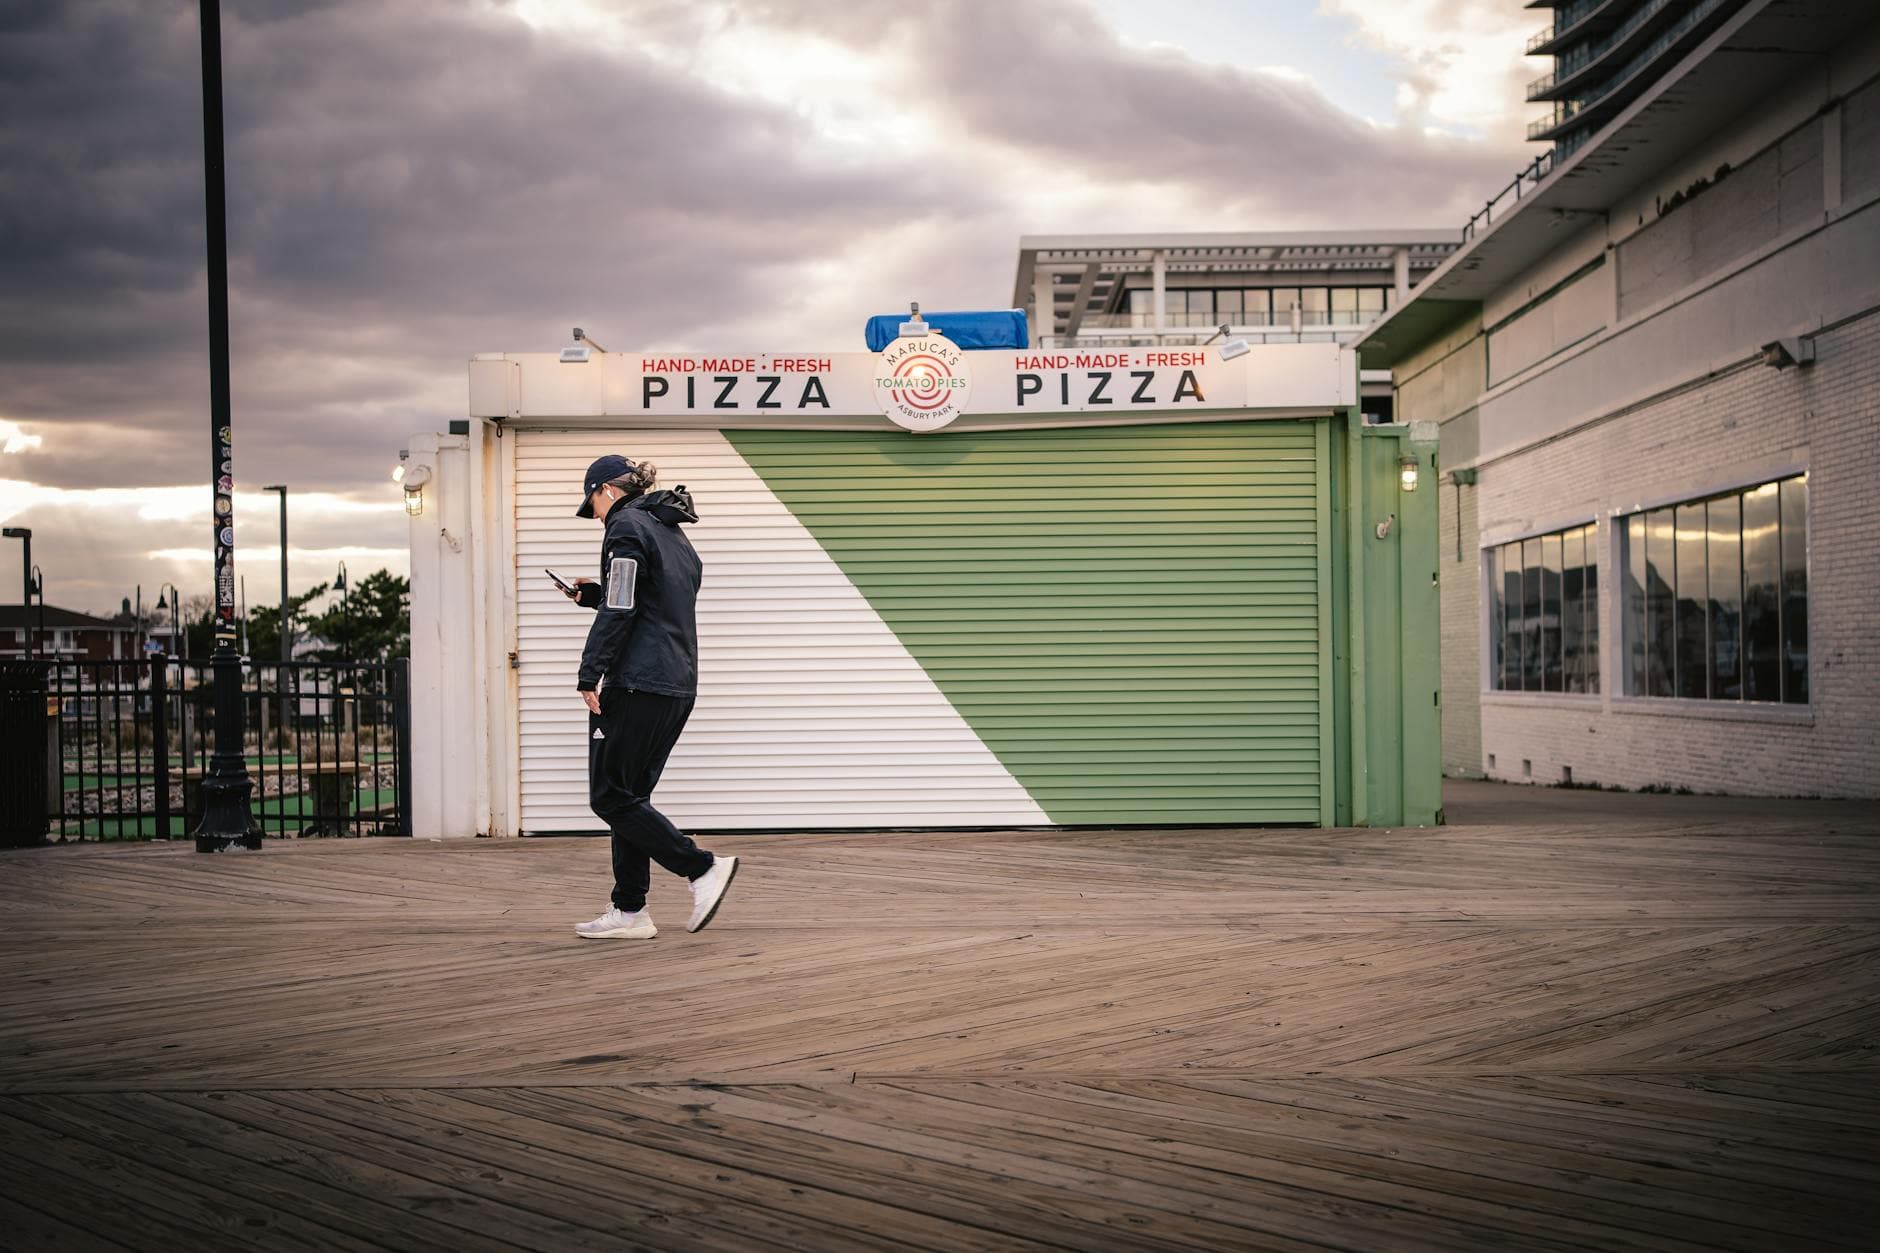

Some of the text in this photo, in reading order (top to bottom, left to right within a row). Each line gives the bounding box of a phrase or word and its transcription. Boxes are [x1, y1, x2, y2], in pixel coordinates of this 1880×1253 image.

[886, 342, 959, 367] MARUCA'S
[1016, 352, 1205, 369] HAND-MADE FRESH
[642, 359, 831, 372] HAND-MADE FRESH
[876, 378, 966, 388] TOMATO PIES
[1016, 370, 1205, 406] PIZZA
[643, 376, 830, 408] PIZZA
[897, 403, 955, 420] ASBURY PARK
